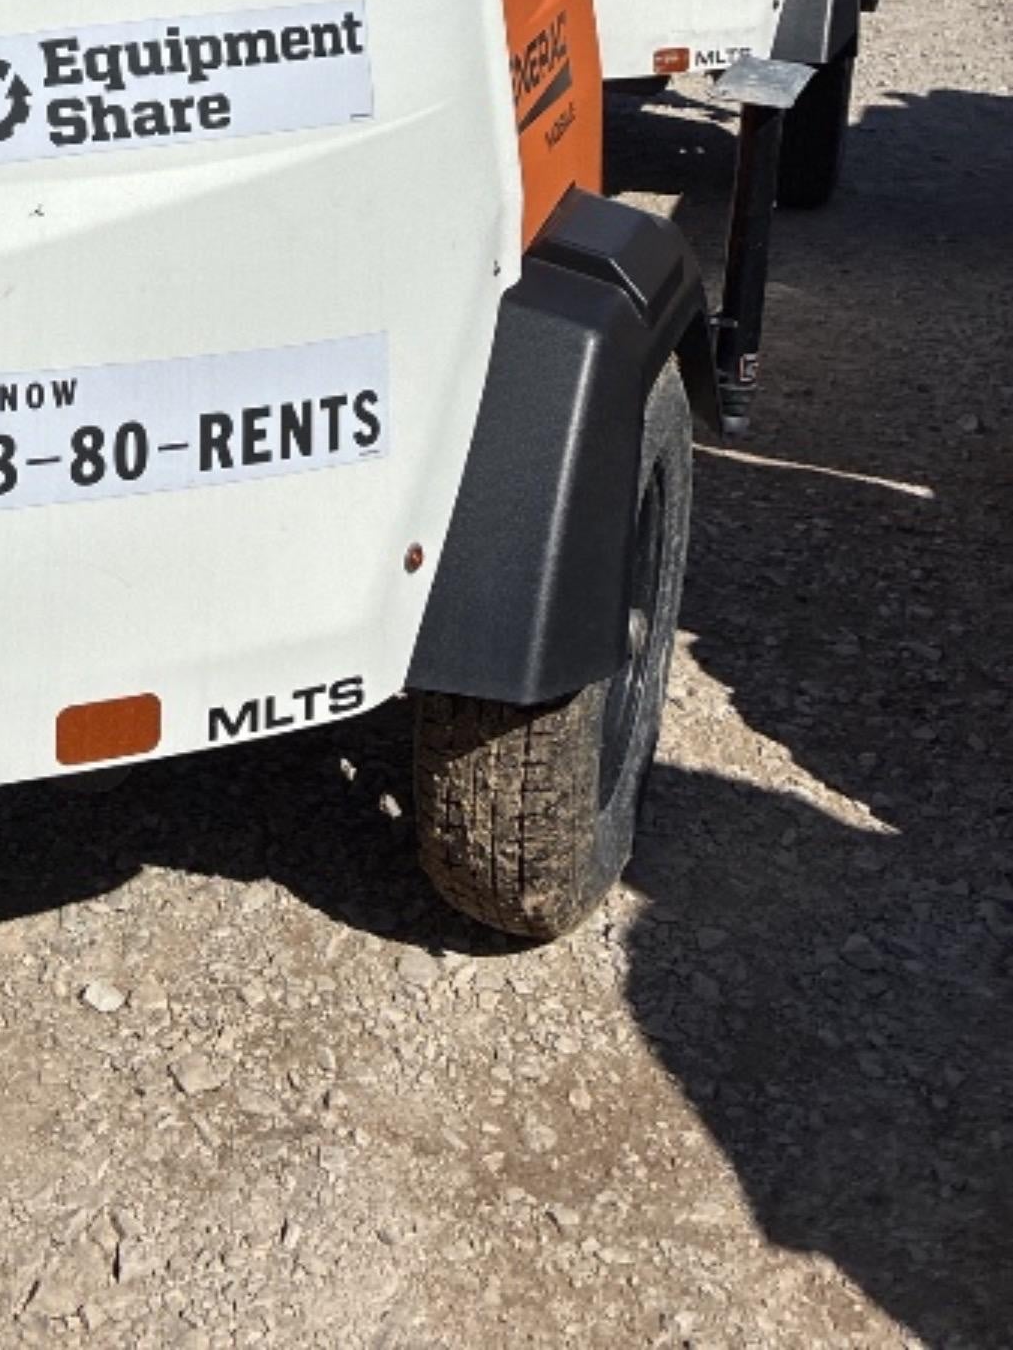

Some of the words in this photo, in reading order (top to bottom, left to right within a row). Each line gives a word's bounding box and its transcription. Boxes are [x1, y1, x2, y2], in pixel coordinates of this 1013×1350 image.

[40, 11, 364, 91] Equipment
[45, 93, 231, 147] Share
[207, 675, 365, 742] MLTS
